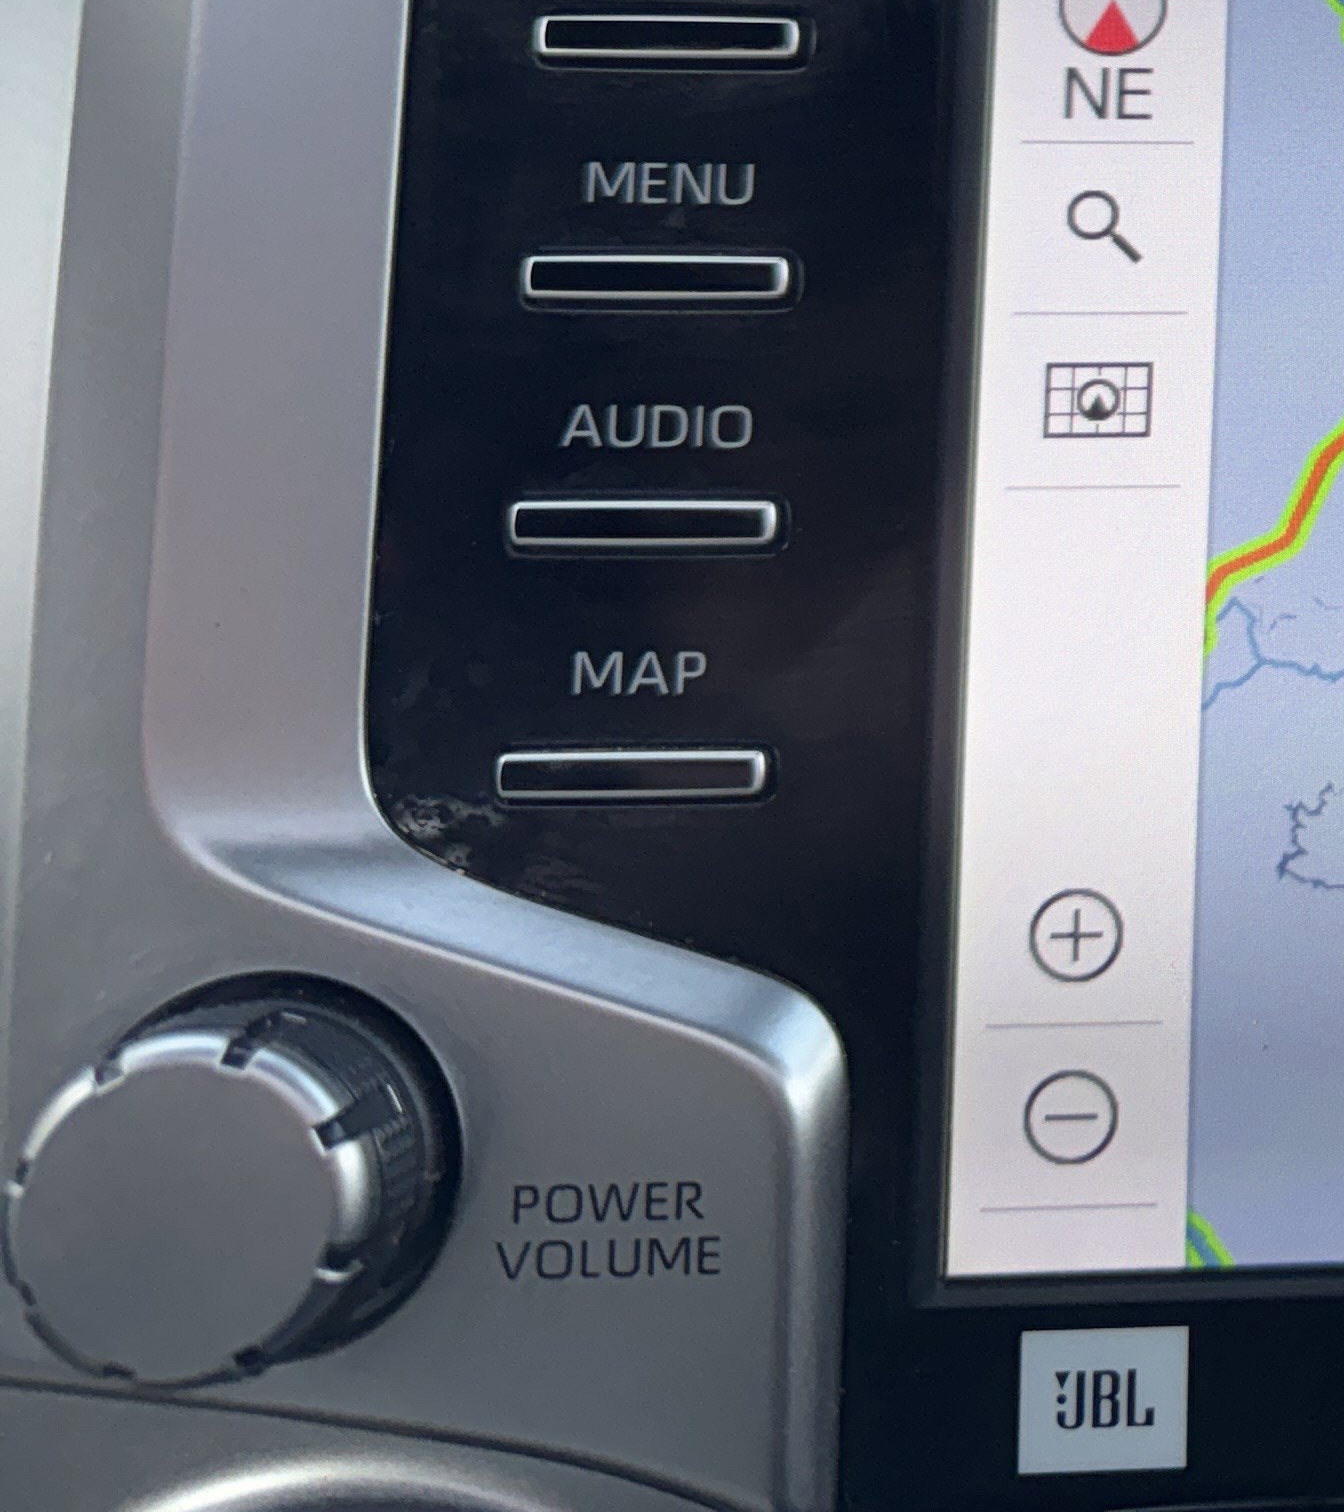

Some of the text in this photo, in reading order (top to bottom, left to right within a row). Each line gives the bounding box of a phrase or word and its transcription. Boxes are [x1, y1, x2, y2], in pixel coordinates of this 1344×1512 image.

[1062, 68, 1154, 122] NE
[583, 161, 756, 207] MENU
[560, 404, 753, 450] AUDIO
[571, 650, 708, 696] MAP
[511, 1180, 705, 1225] POWER
[495, 1235, 722, 1281] VOLUME
[1055, 1368, 1156, 1430] JBL
